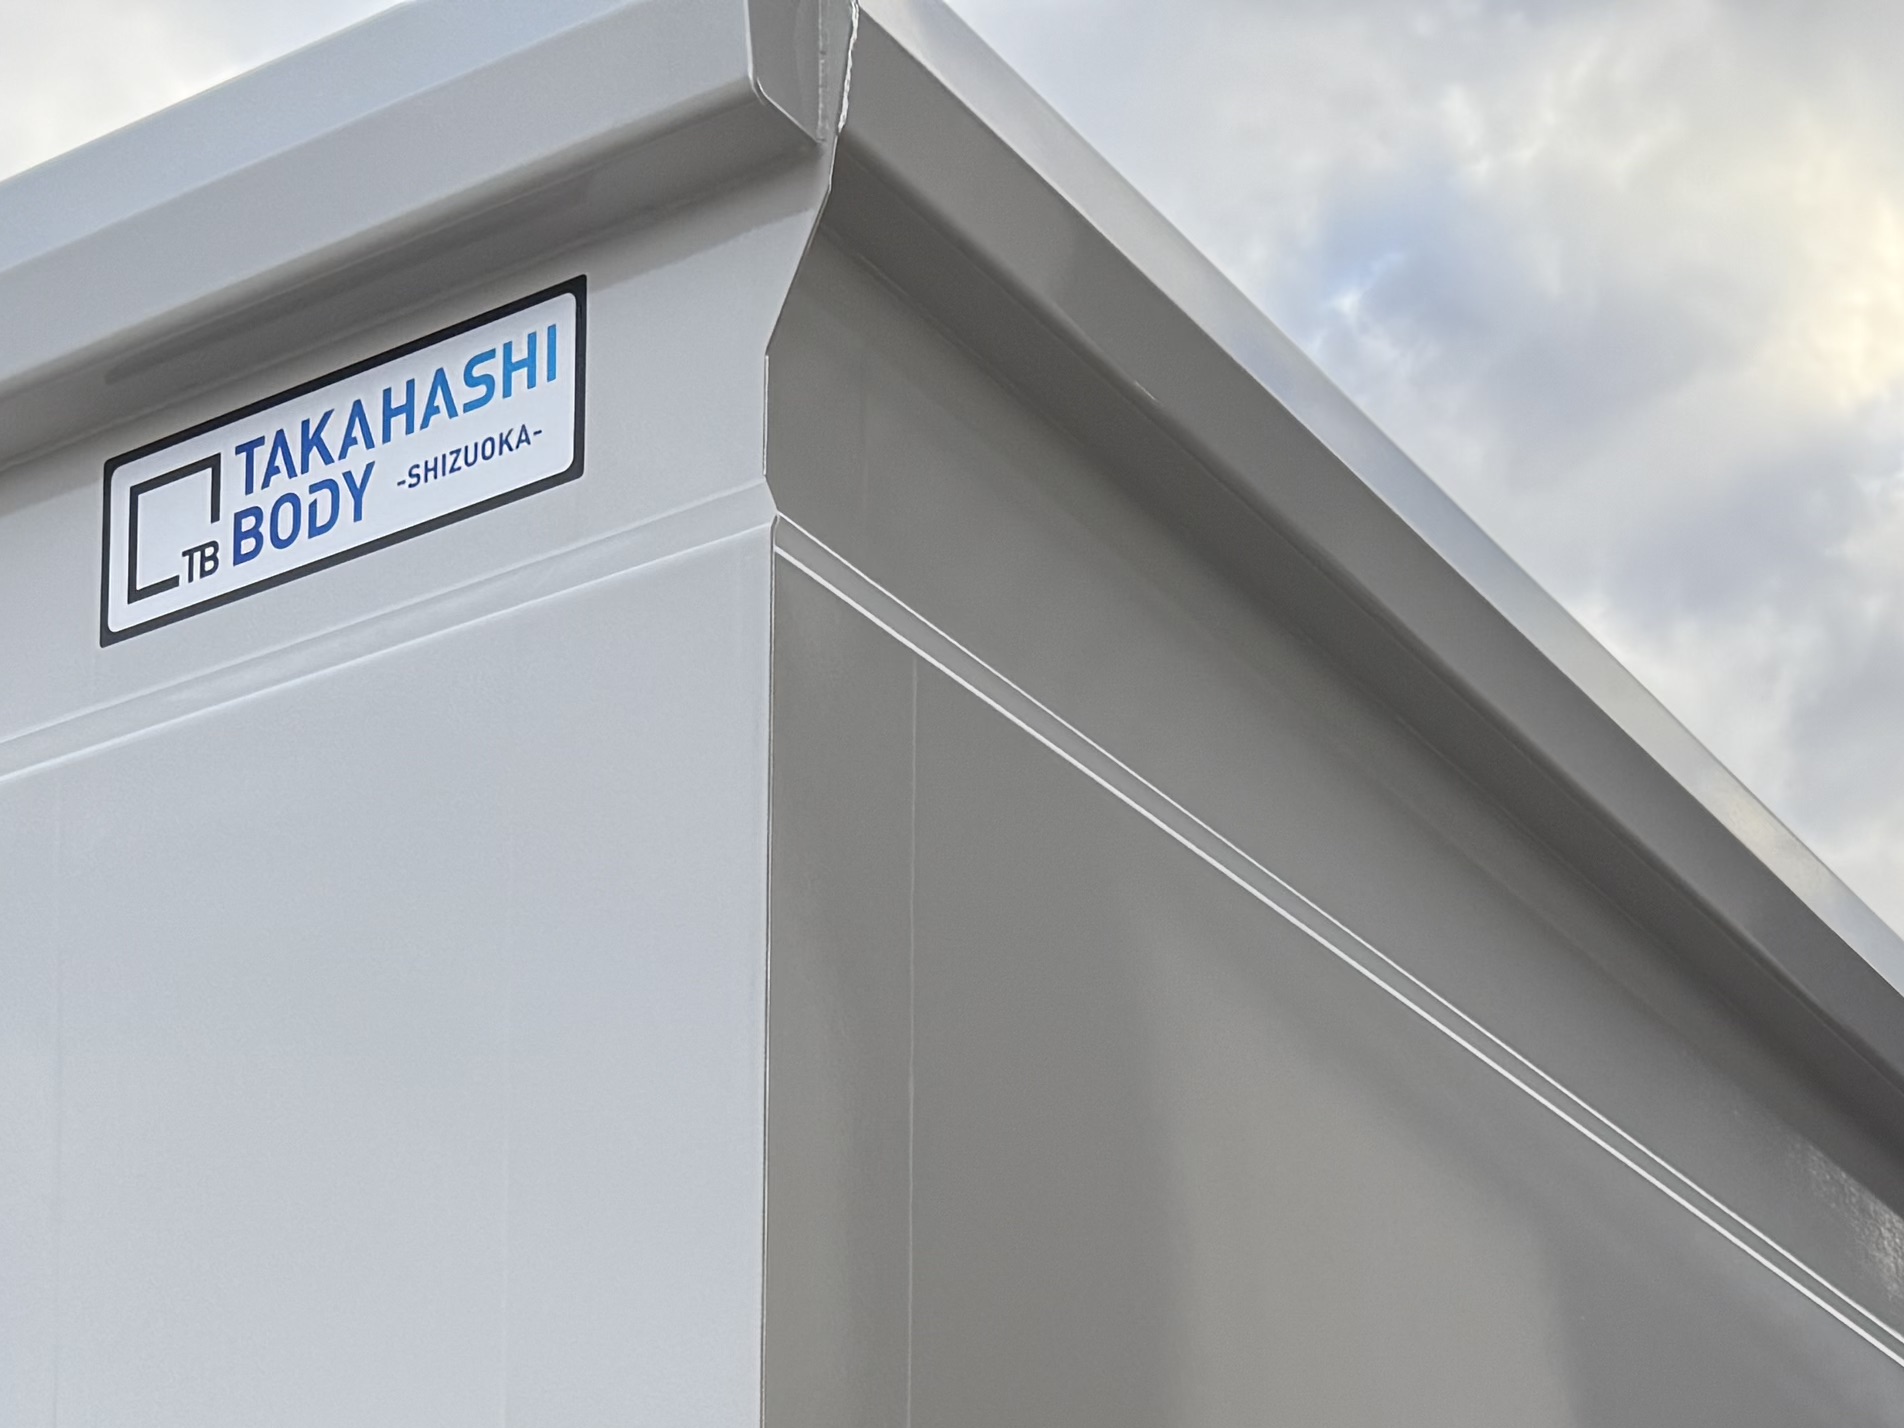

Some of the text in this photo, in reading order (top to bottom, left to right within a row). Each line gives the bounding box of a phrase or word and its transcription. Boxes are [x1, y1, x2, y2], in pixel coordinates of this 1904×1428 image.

[234, 323, 557, 496] TAKAHASHI
[181, 540, 220, 584] TB
[232, 423, 543, 567] BODY -SHIZUOKA-
